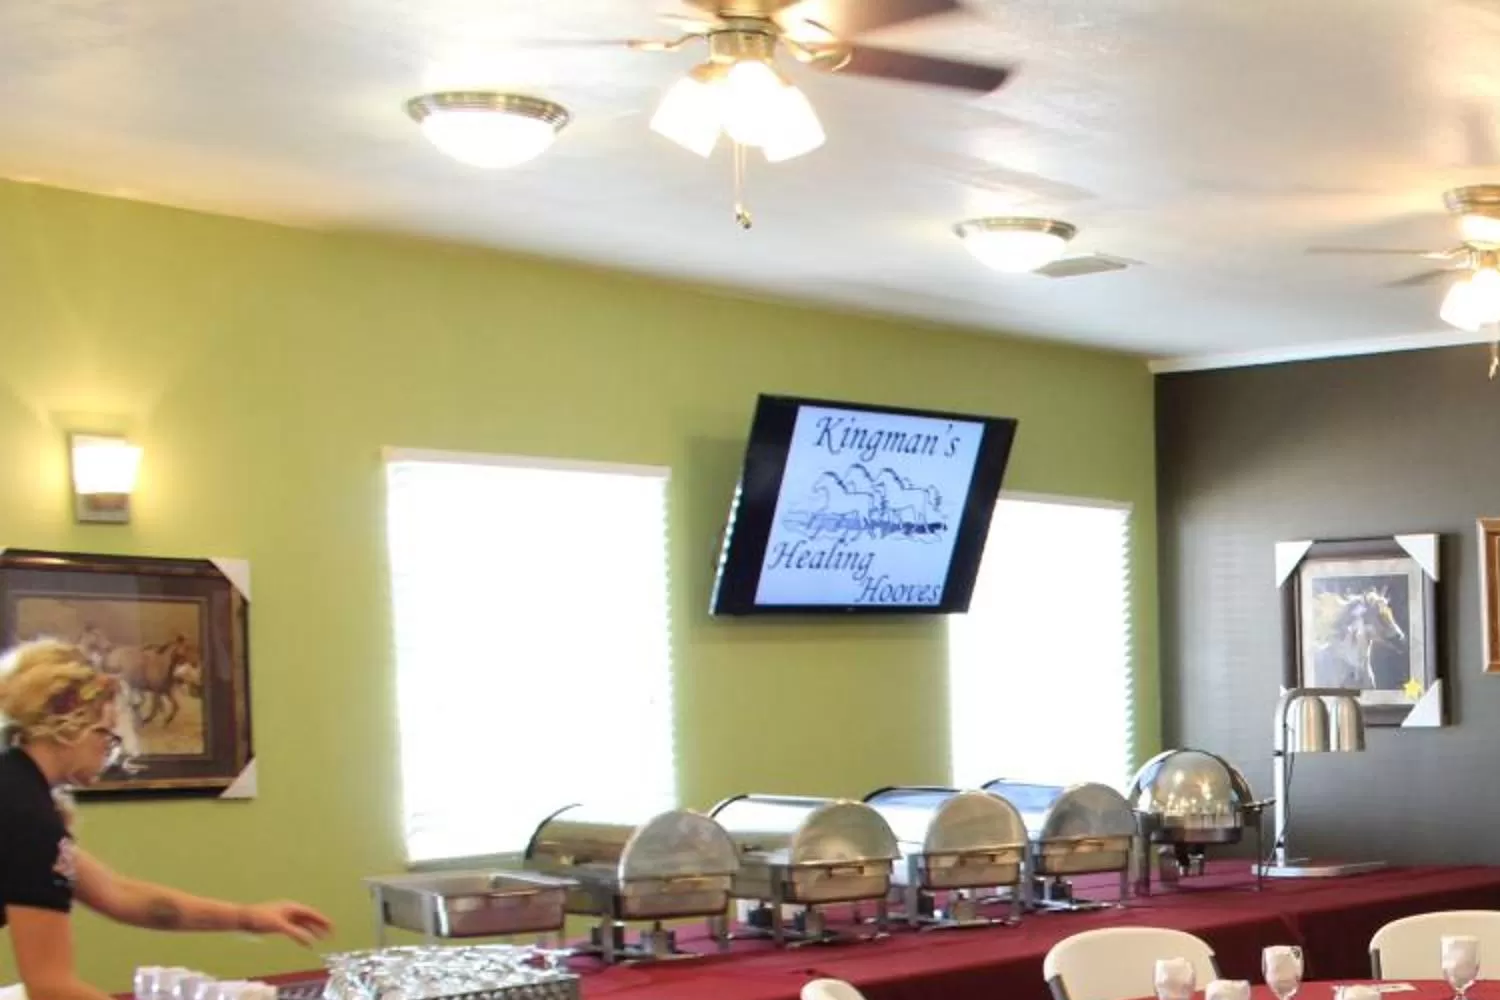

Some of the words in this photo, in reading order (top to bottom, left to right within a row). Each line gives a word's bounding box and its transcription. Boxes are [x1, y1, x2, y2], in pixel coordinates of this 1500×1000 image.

[812, 415, 962, 462] Kingman's
[767, 538, 876, 581] Healing
[854, 574, 941, 604] Hooves
